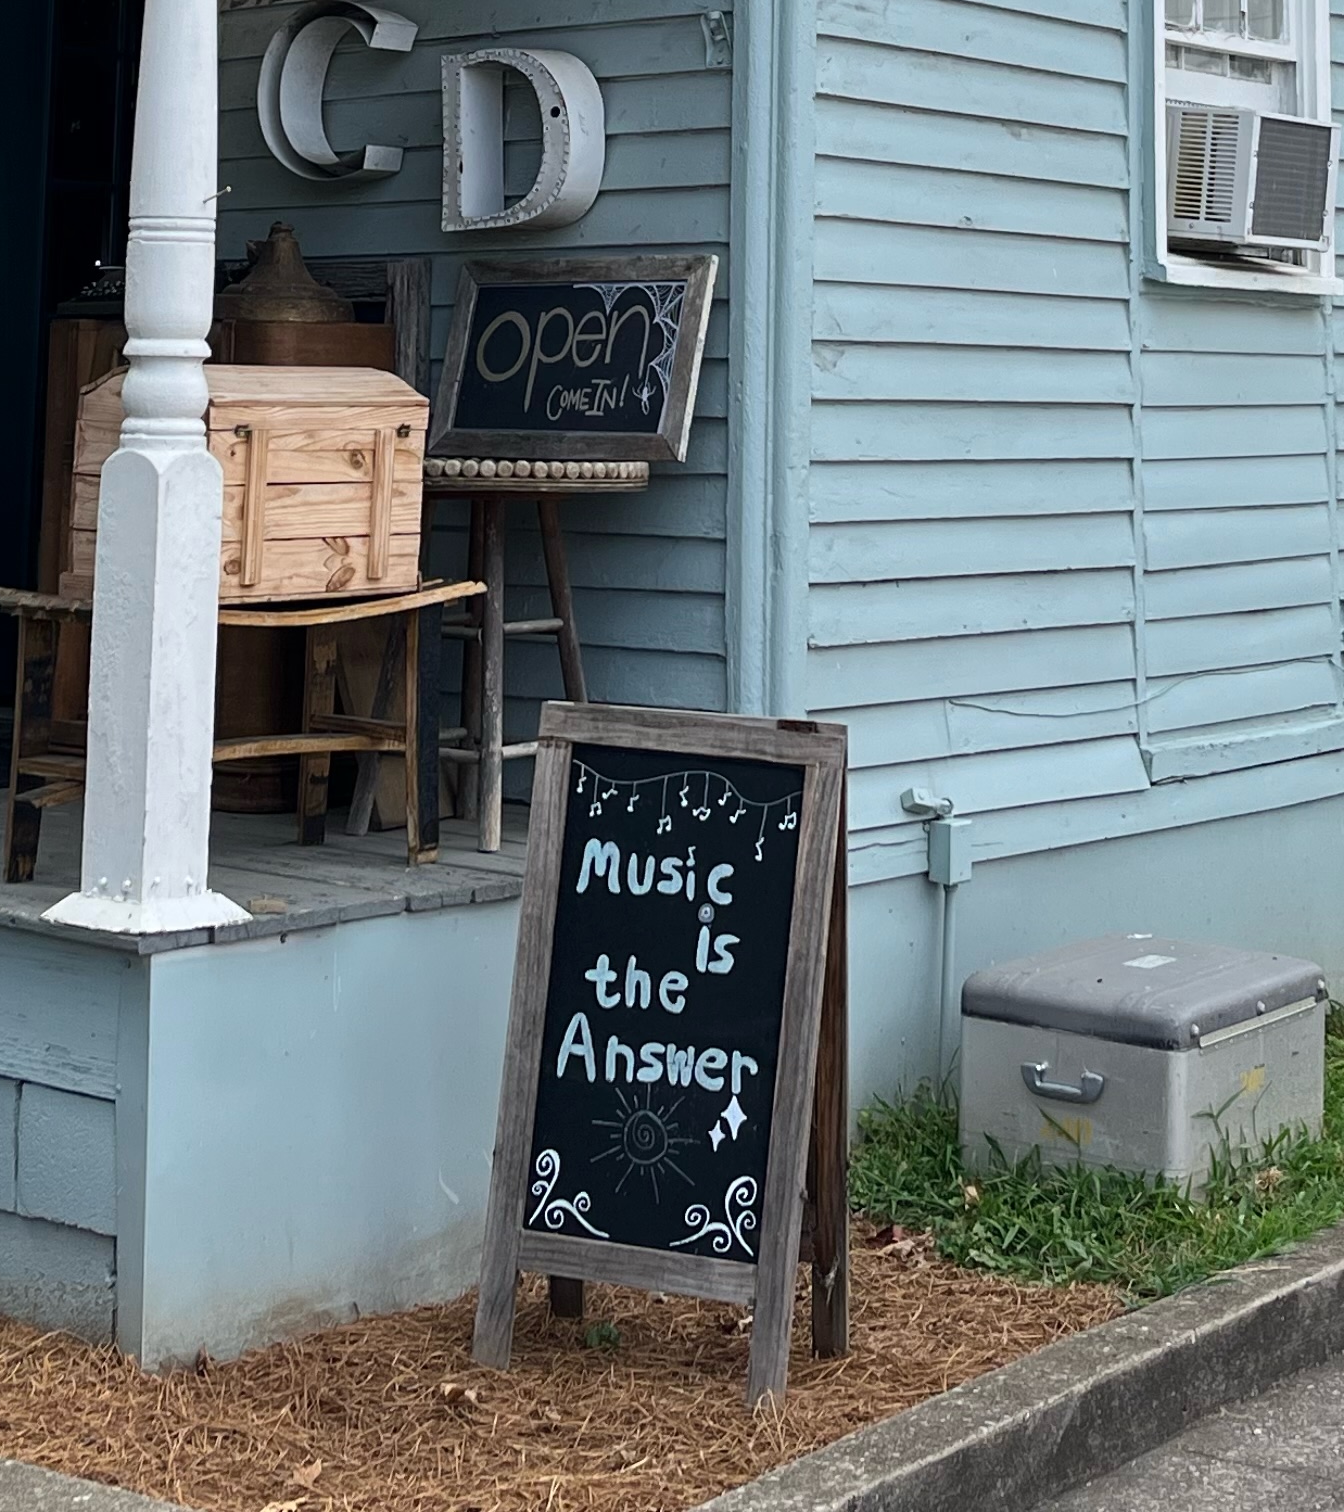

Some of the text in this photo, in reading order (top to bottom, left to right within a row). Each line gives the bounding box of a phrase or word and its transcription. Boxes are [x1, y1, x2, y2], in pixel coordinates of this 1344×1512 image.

[258, 0, 606, 232] C D
[476, 304, 650, 414] open
[576, 838, 734, 903] Music
[696, 903, 740, 975] is
[585, 954, 688, 1013] the
[557, 1012, 758, 1093] Answer
